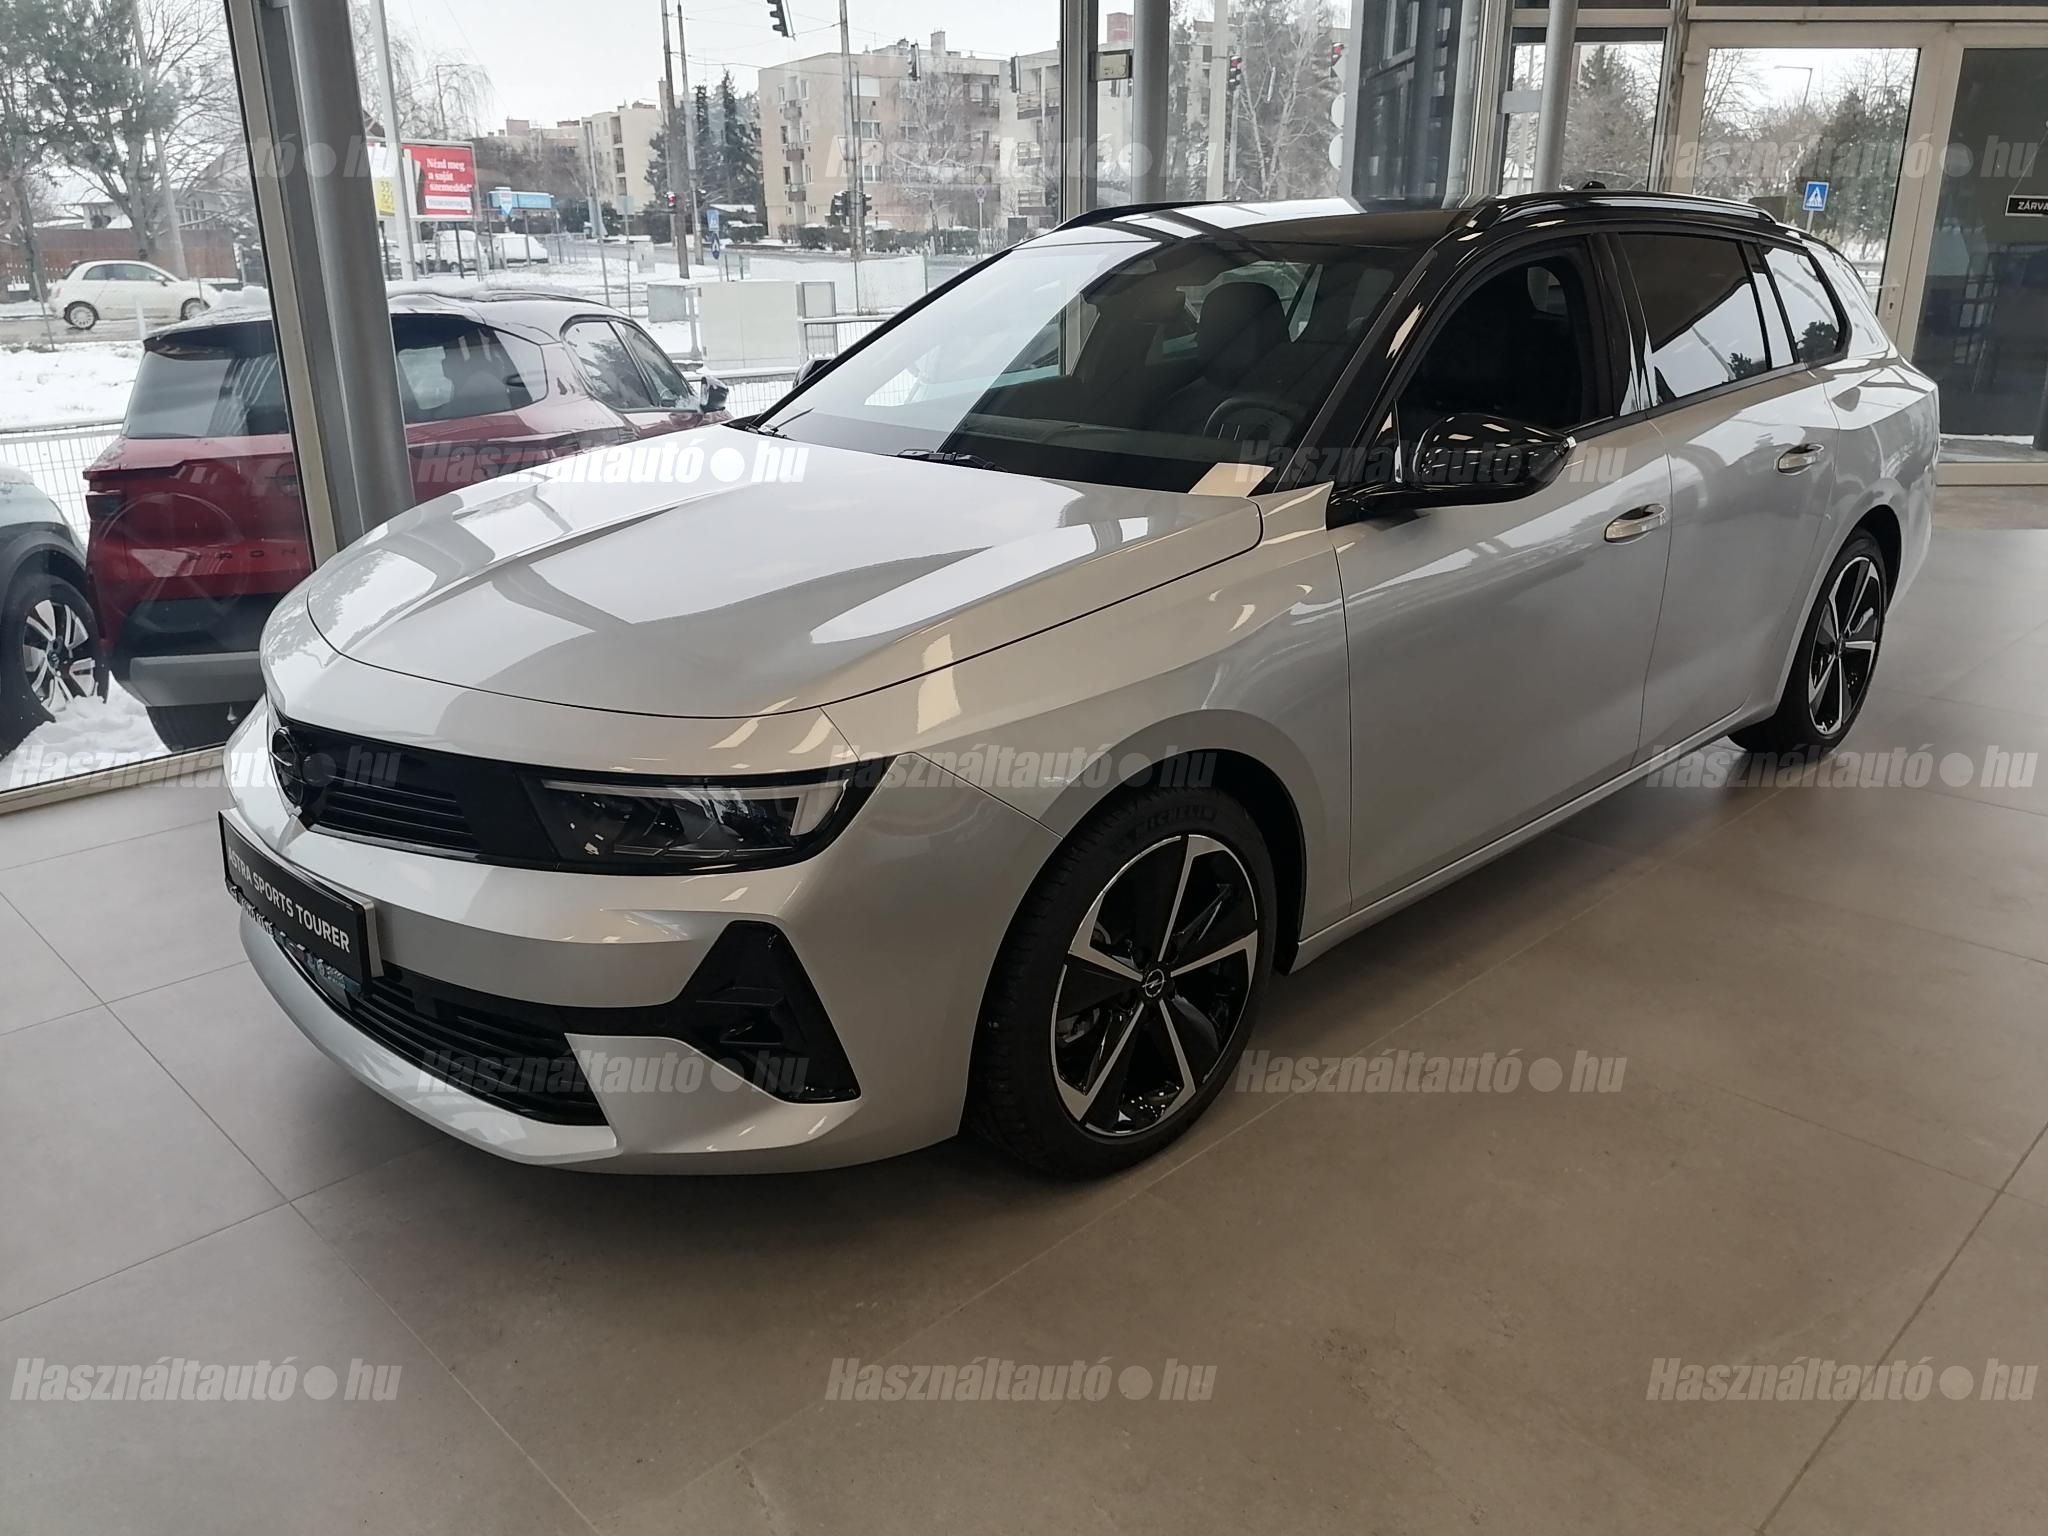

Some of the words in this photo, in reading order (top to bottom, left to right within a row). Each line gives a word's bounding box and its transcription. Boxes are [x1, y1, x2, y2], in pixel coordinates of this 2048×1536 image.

[228, 846, 253, 885] ASTRA
[252, 870, 295, 918] SPORTS
[295, 903, 351, 953] TOURER
